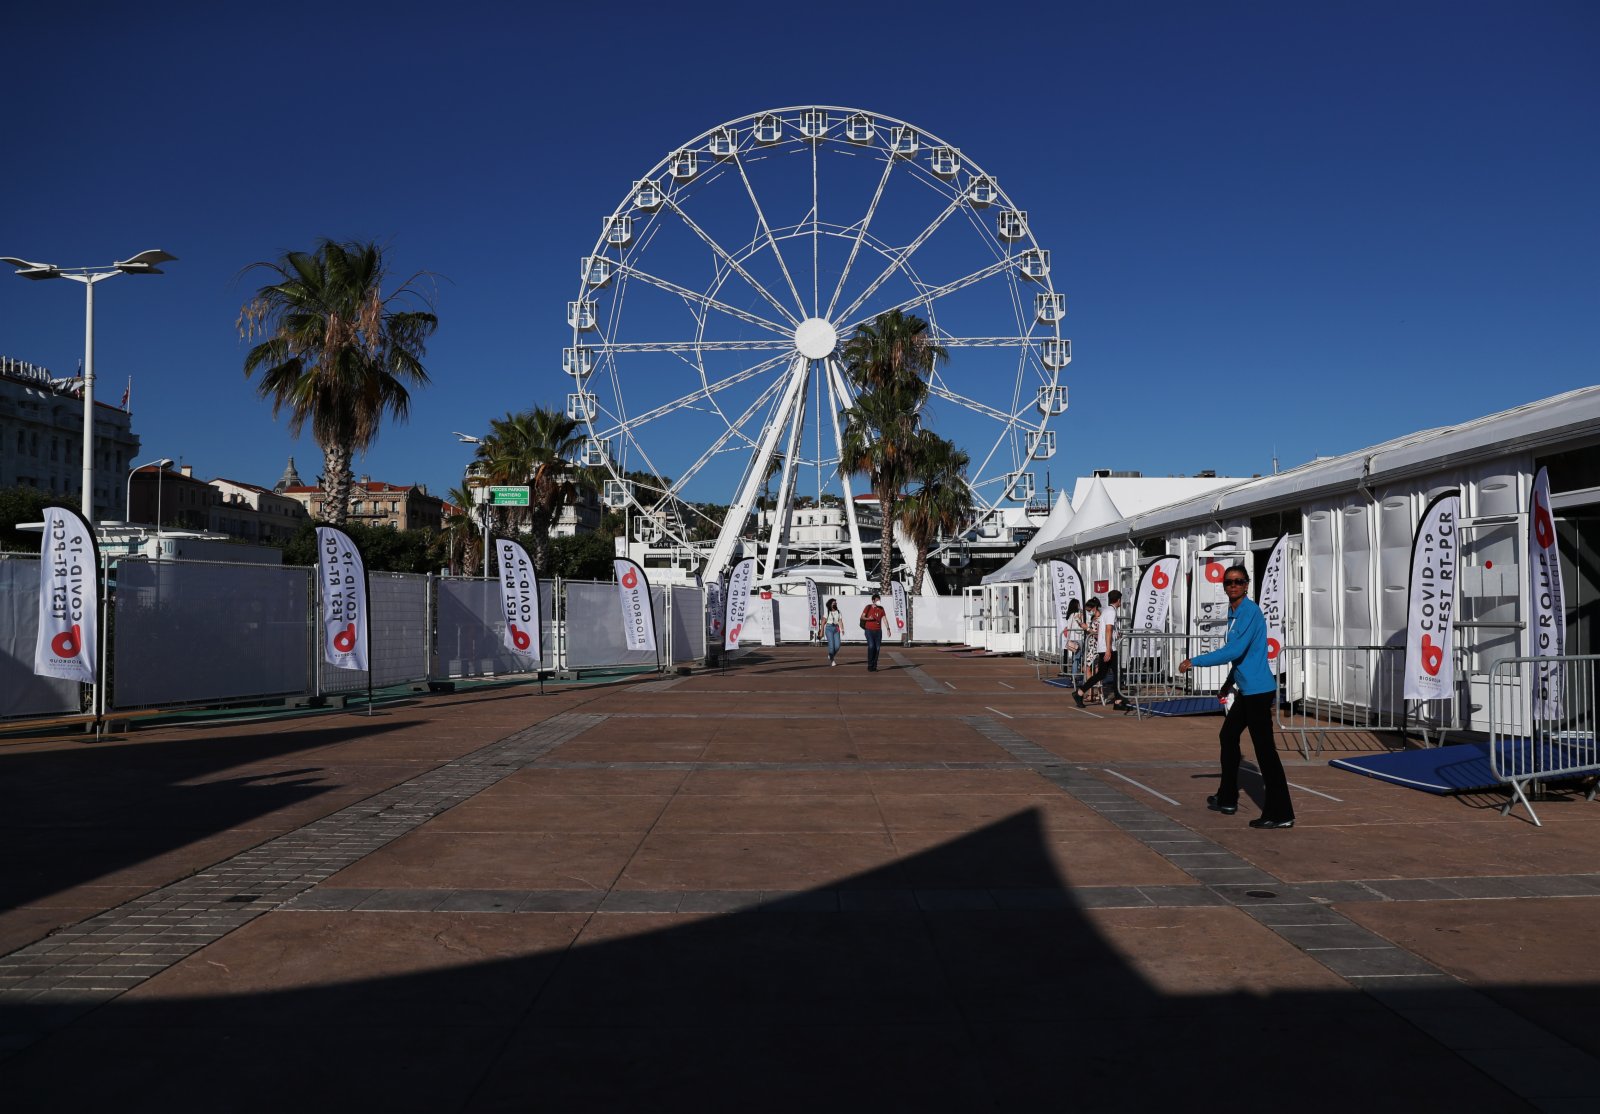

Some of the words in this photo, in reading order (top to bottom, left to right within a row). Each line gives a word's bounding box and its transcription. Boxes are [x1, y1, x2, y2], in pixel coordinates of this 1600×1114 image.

[164, 541, 173, 554] 10
[504, 544, 515, 588] RT-PCR
[1439, 512, 1452, 580] RT-PCR
[518, 558, 531, 622] COVID-19
[1421, 533, 1434, 631] COVID-19
[507, 594, 516, 622] TEST
[1438, 590, 1452, 633] TEST
